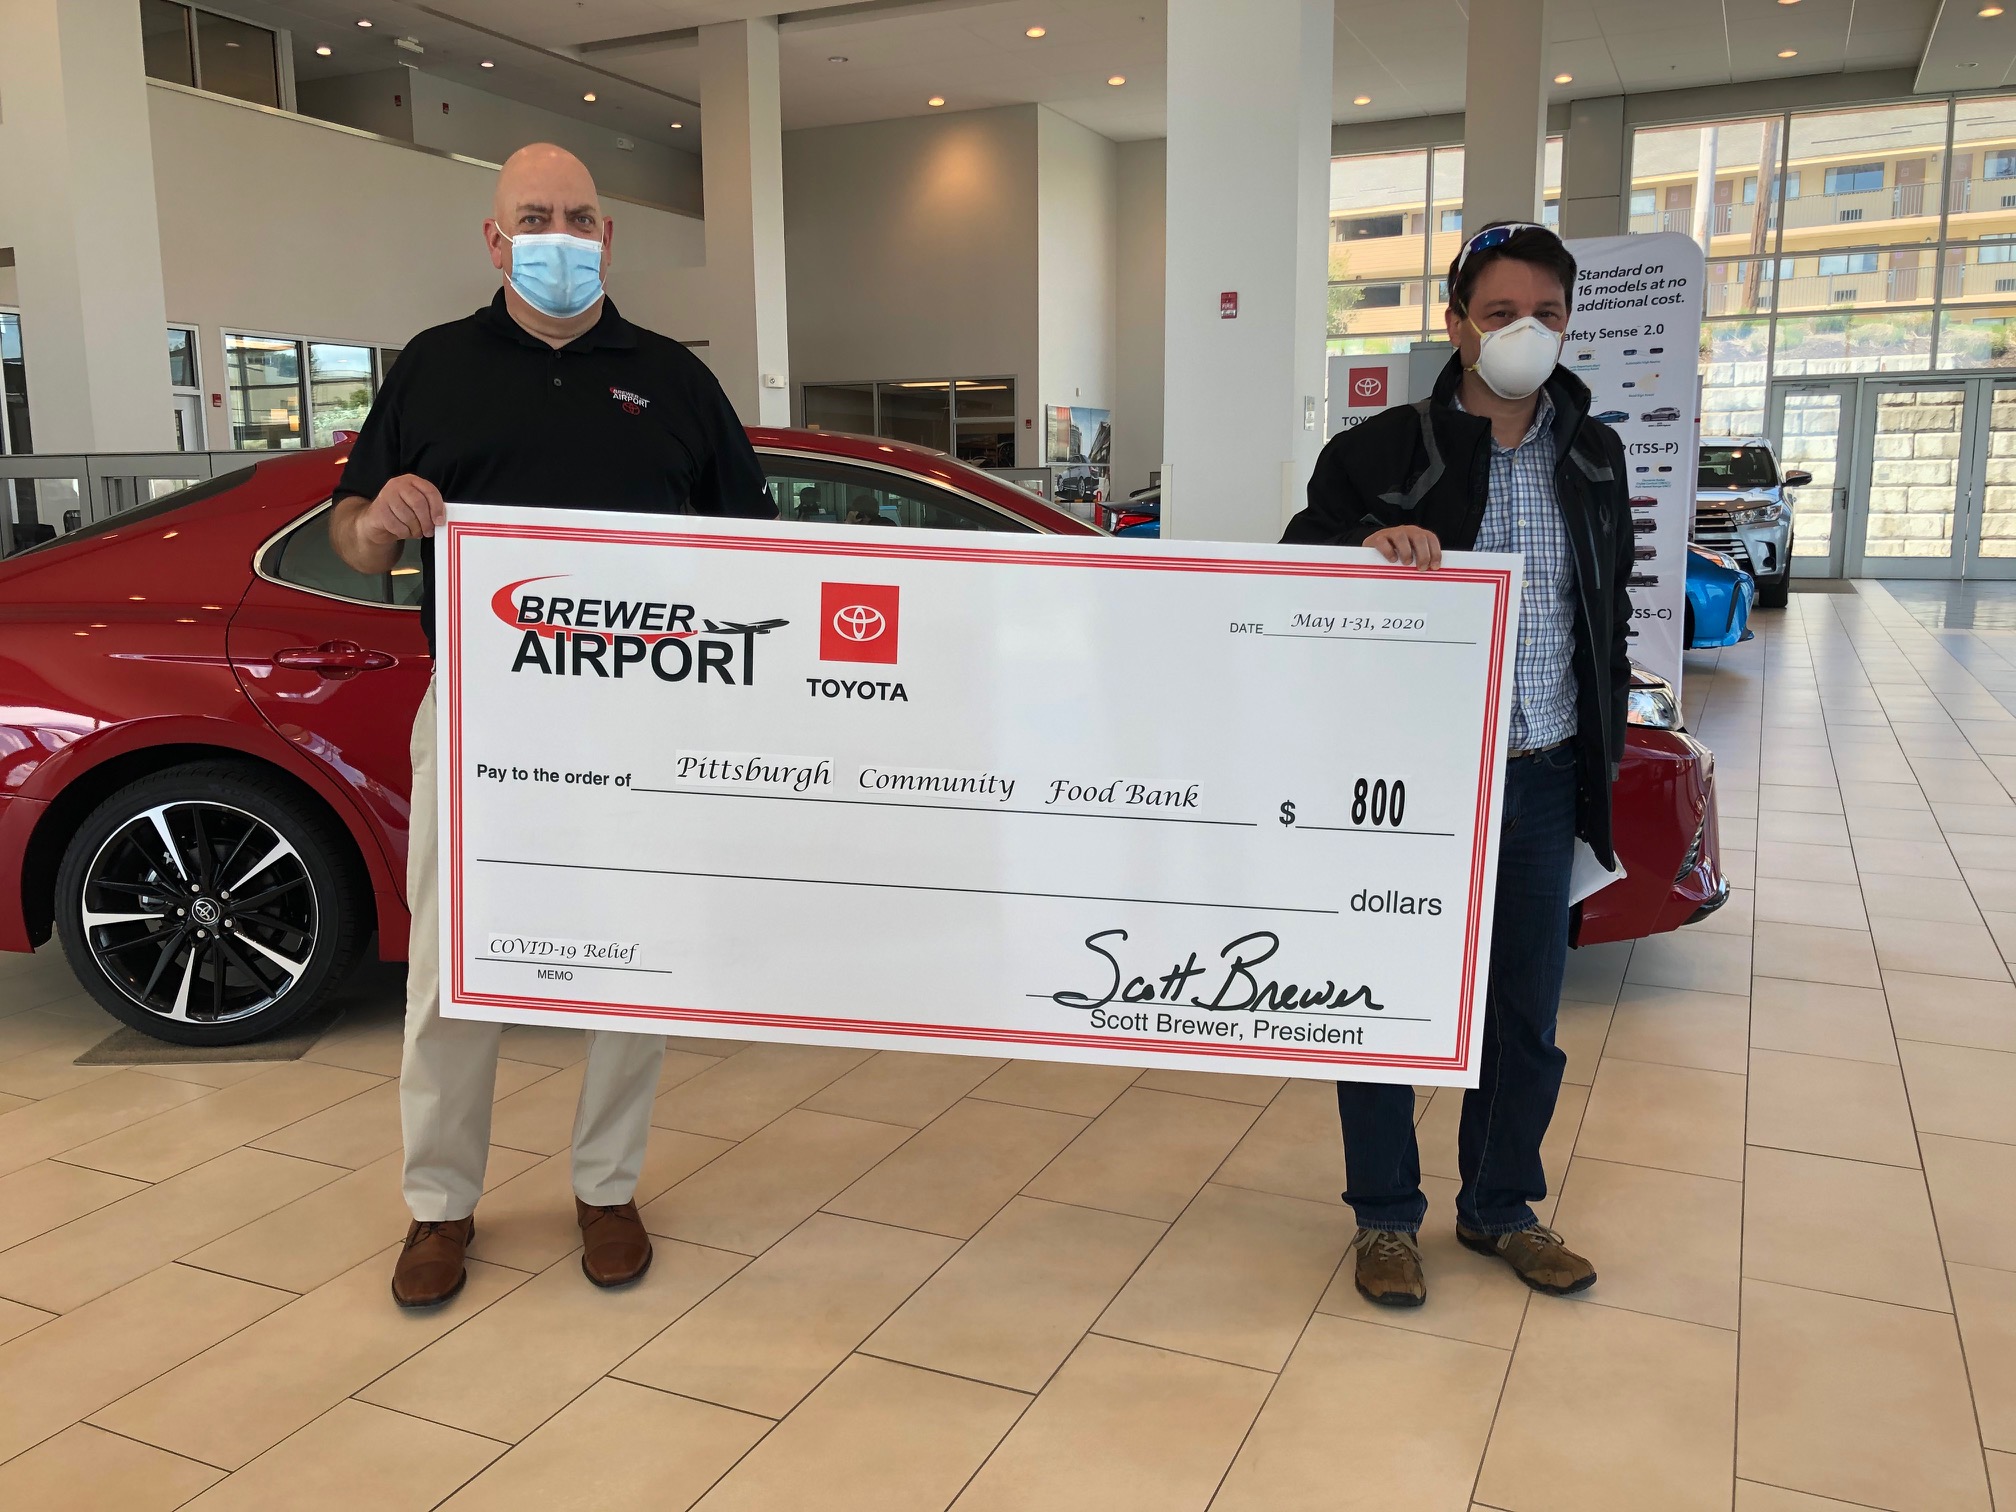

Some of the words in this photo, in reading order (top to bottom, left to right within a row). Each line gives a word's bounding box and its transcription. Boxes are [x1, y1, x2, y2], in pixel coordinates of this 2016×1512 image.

[1578, 264, 1643, 281] Standard
[1645, 263, 1664, 275] on
[1578, 285, 1592, 296] 16
[1594, 281, 1647, 295] models
[1650, 279, 1665, 290] at
[1668, 277, 1687, 288] no
[1577, 294, 1648, 312] additional
[1651, 292, 1685, 305] cost.
[1564, 329, 1597, 342] afety
[1599, 328, 1638, 339] Sense
[1644, 324, 1665, 336] 2.0
[613, 389, 639, 398] BREWER
[613, 393, 648, 408] AIRPORT
[1341, 416, 1368, 426] TOY
[1629, 442, 1679, 455] (TSS-P)
[516, 595, 696, 633] BREWER
[1229, 622, 1264, 634] DATE
[1291, 613, 1336, 633] May
[1341, 616, 1375, 631] 1-31,
[1381, 617, 1425, 630] 2020
[1631, 608, 1672, 620] SS-C)
[511, 629, 755, 686] AIRPORT
[806, 677, 909, 702] TOYOTA
[476, 763, 506, 783] Pay
[512, 766, 529, 781] to
[533, 767, 560, 783] the
[564, 770, 610, 786] order
[614, 773, 632, 787] of
[676, 756, 832, 792] Pittsburgh
[858, 768, 1016, 802] Community
[1045, 778, 1123, 805] Food
[1124, 783, 1200, 808] Bank
[1278, 799, 1296, 827] $
[1351, 777, 1406, 827] 800
[1350, 888, 1443, 916] dollars
[490, 938, 577, 959] COVID-19
[583, 942, 640, 965] Relief
[537, 969, 574, 981] MEMO
[1053, 929, 1206, 1010] Scott
[1191, 931, 1384, 1012] Brewer
[1089, 1008, 1149, 1032] Scott
[1156, 1012, 1245, 1041] Brewer,
[1253, 1018, 1364, 1046] President
